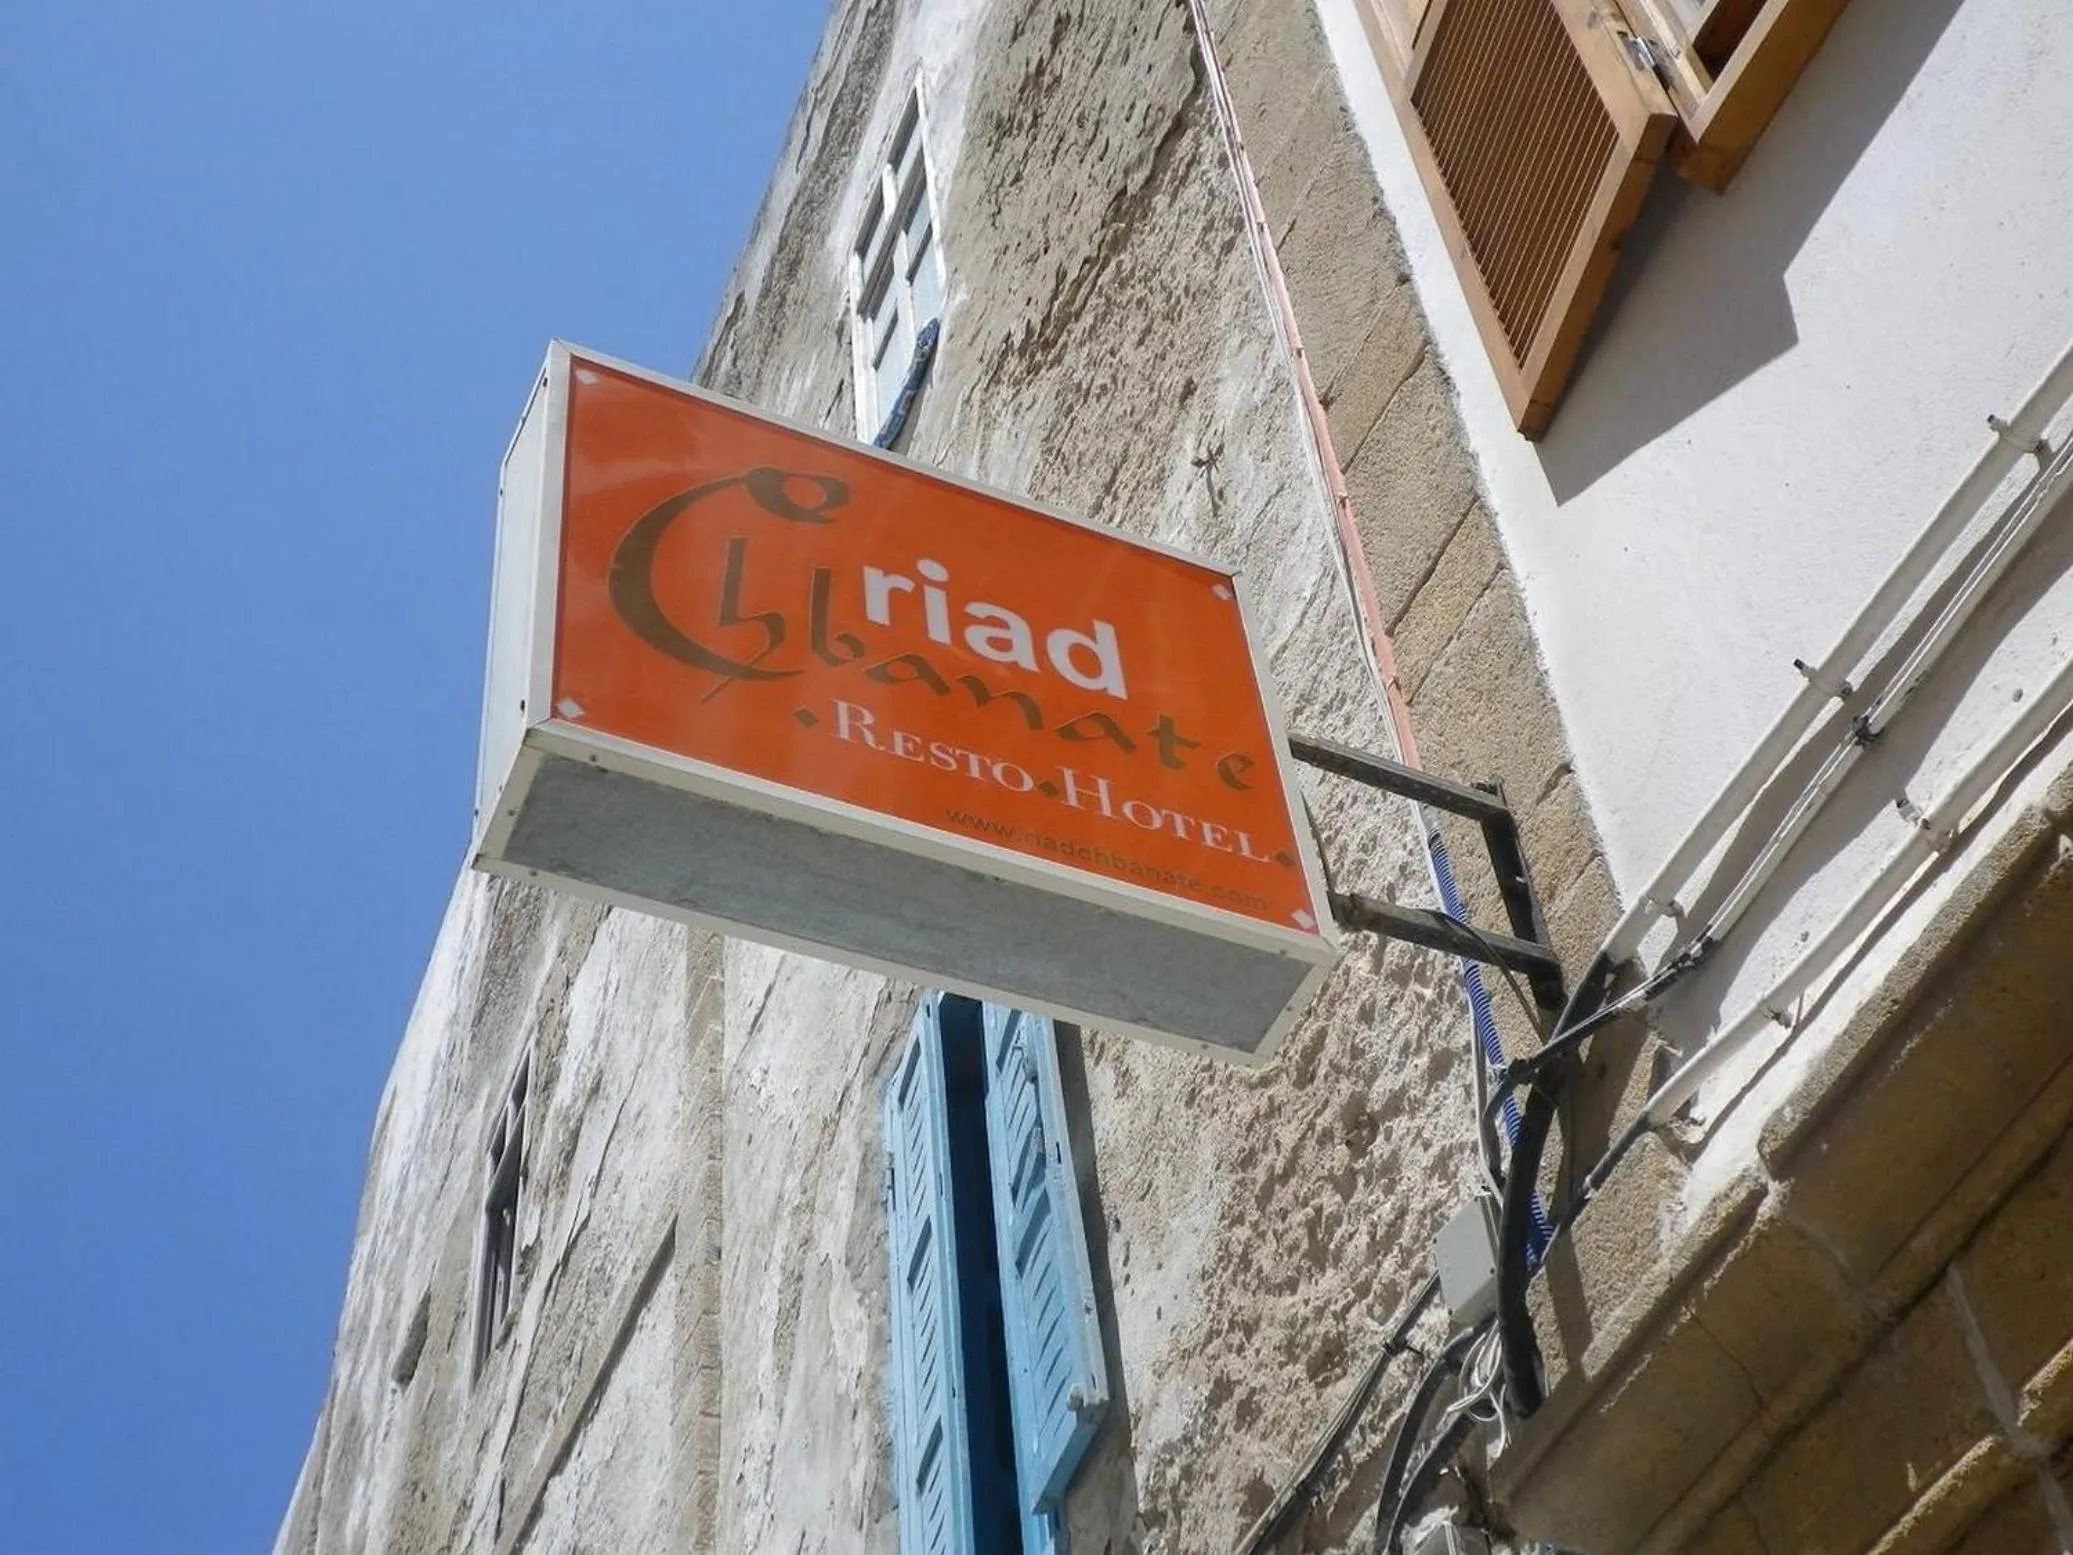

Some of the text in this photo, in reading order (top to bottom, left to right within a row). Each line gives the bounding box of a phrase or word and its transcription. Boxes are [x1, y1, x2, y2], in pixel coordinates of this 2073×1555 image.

[609, 467, 1255, 790] Chbanate
[863, 560, 1129, 699] riad
[946, 809, 1269, 909] www.riadchbanate.com
